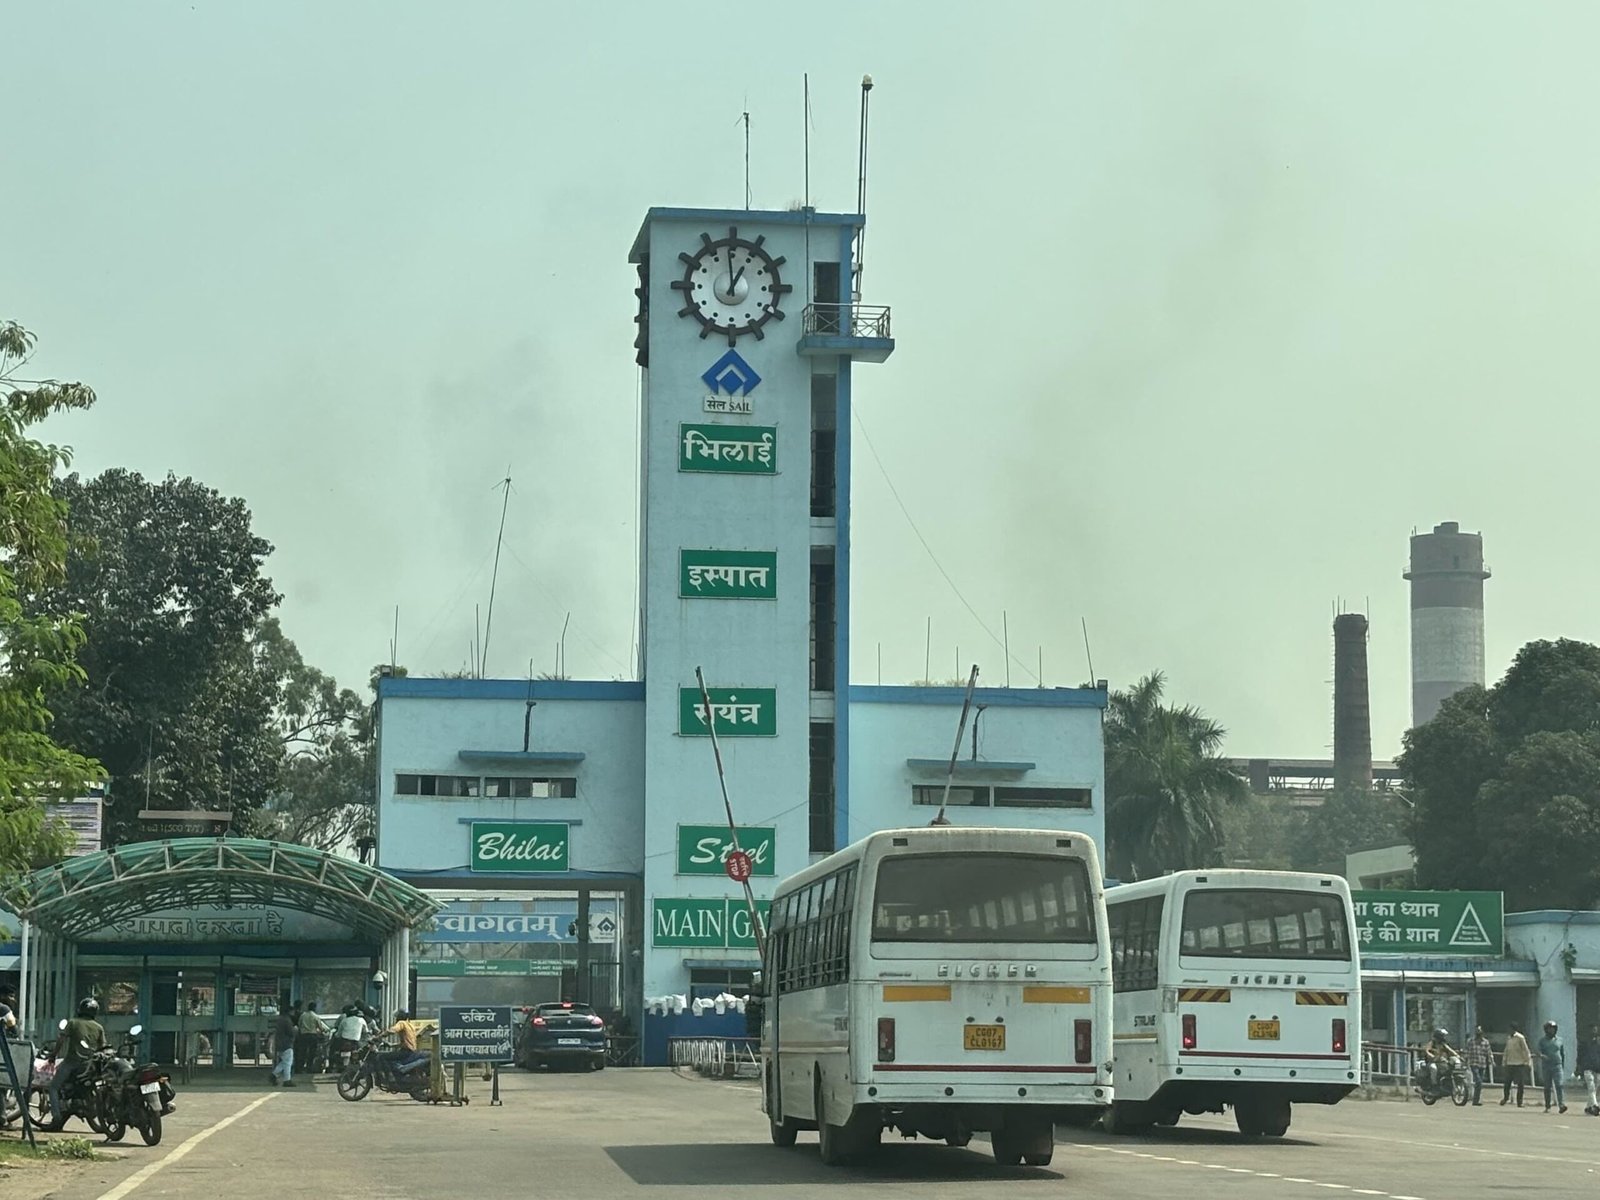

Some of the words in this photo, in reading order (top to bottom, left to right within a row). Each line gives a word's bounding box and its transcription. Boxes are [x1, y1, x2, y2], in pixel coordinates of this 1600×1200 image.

[706, 396, 726, 410] सेल
[729, 402, 752, 412] SAIL
[683, 430, 773, 467] भिलाई
[687, 565, 770, 591] इस्पात
[477, 831, 564, 861] Bhilai
[690, 837, 769, 864] Stel
[730, 858, 739, 876] STOP
[1372, 902, 1396, 917] का
[1400, 901, 1440, 917] ध्यान
[196, 917, 262, 936] करता
[266, 910, 285, 936] है
[656, 908, 722, 938] MAIN
[732, 908, 772, 938] GA
[1378, 920, 1401, 943] की
[1406, 928, 1440, 943] शान
[938, 964, 1037, 977] EICHER
[1230, 974, 1306, 985] EICHER
[975, 1028, 997, 1037] CG07
